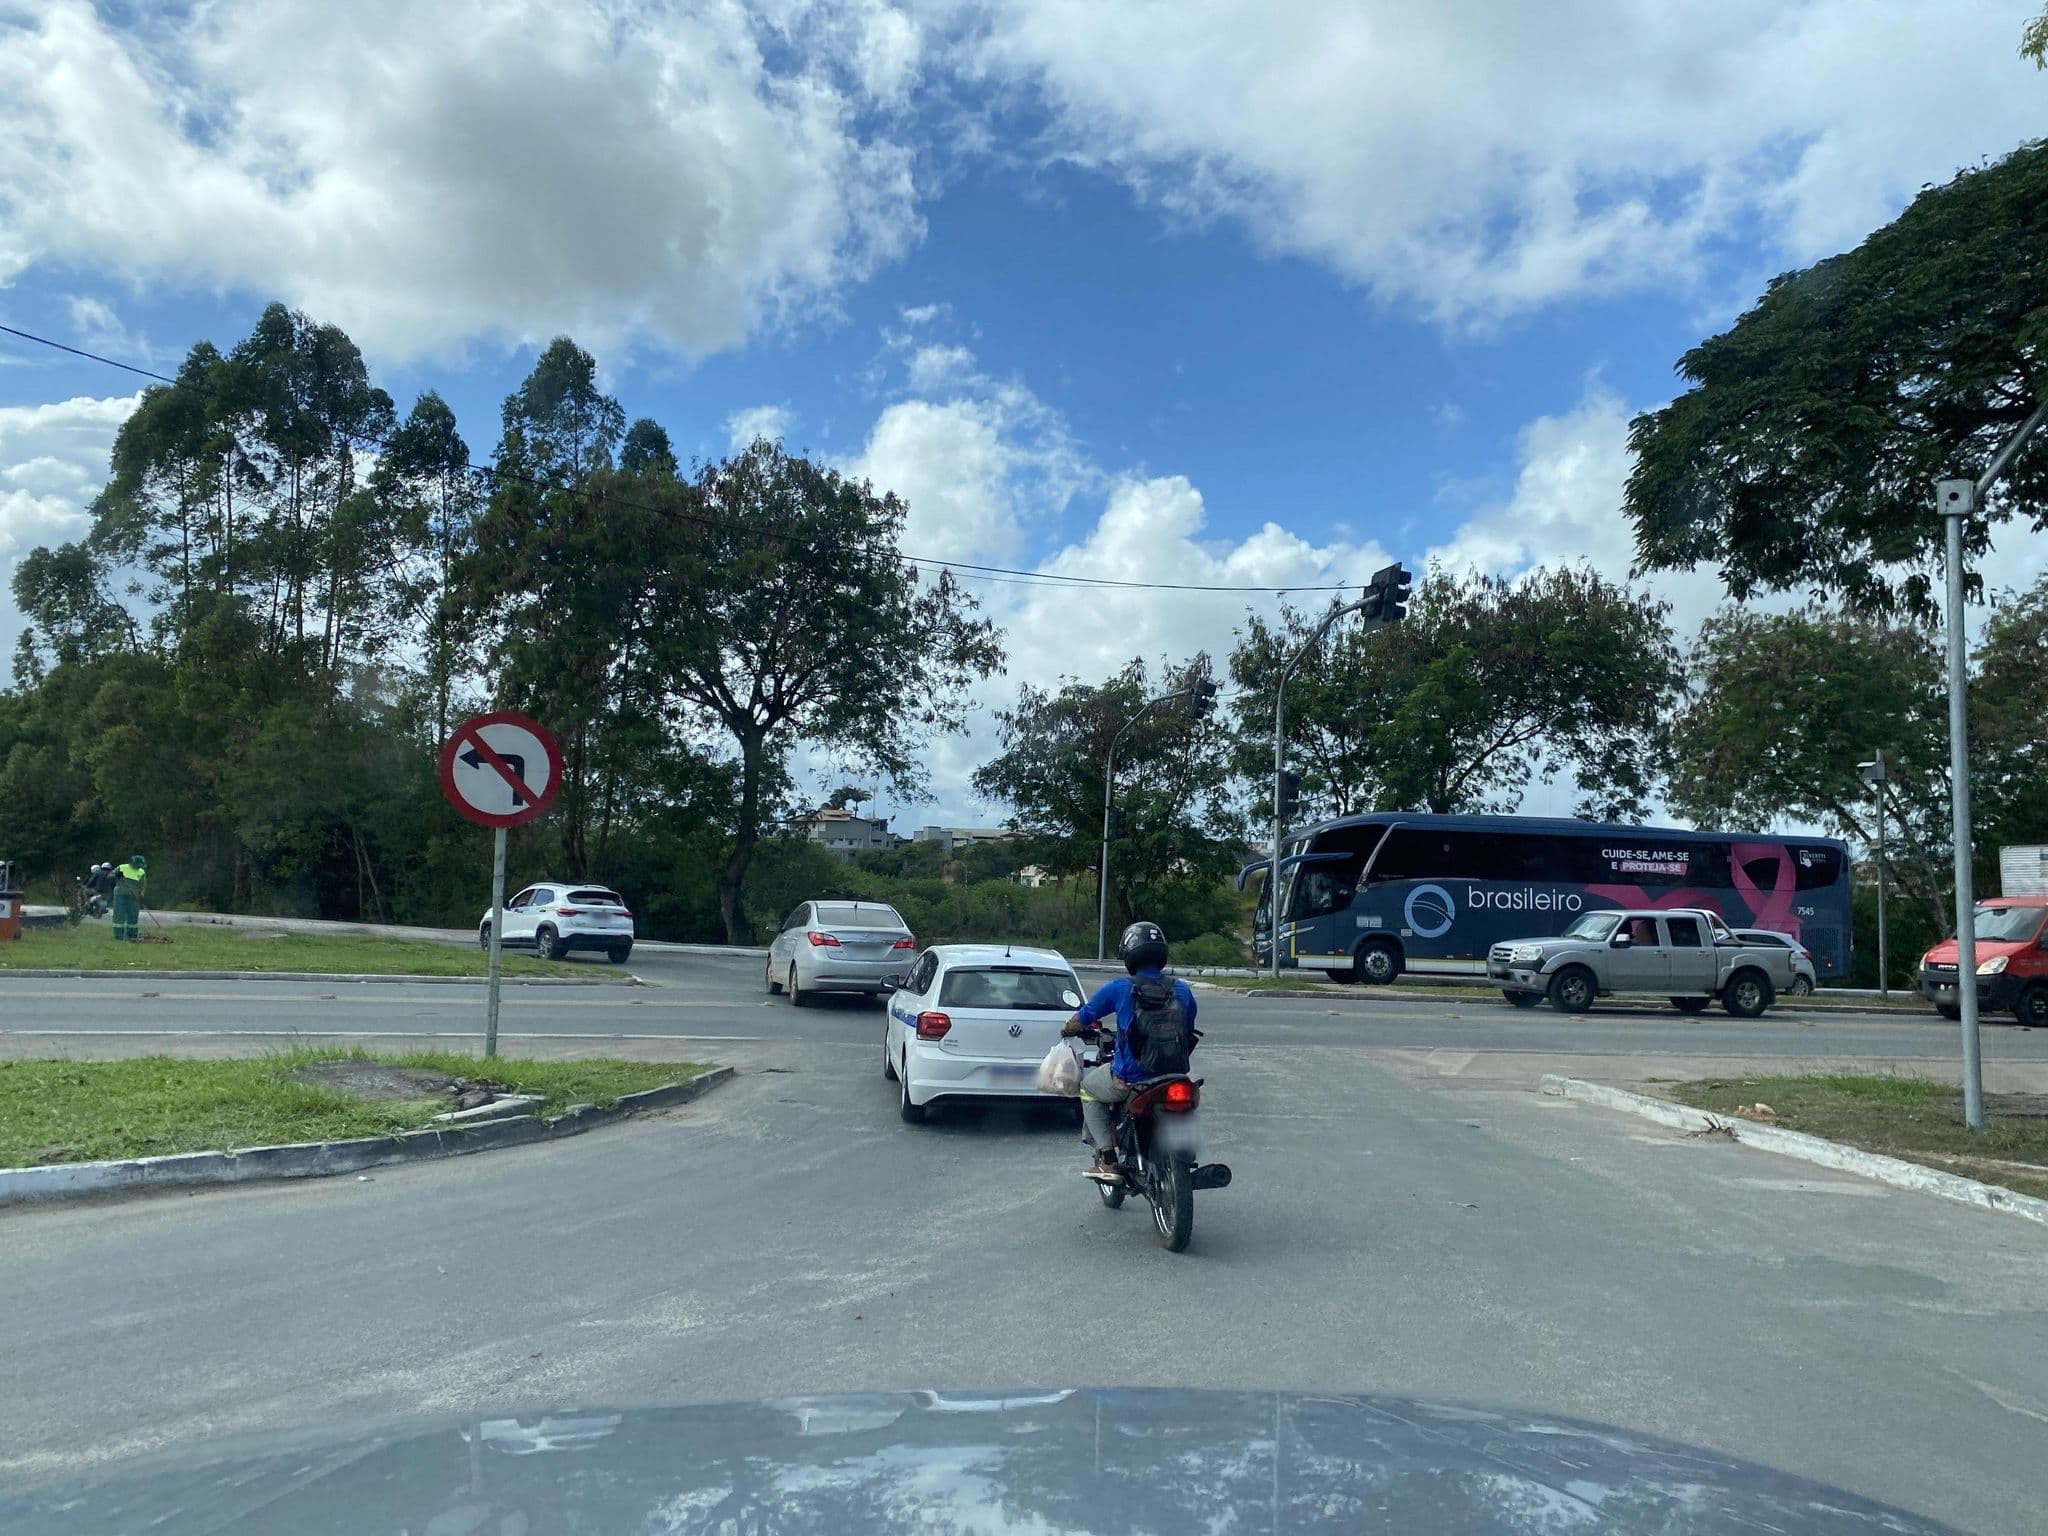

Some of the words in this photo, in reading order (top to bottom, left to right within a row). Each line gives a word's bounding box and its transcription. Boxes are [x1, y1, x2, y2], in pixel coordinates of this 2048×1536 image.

[1602, 849, 1650, 860] CUIDE-SE,
[1652, 851, 1689, 861] AME-SE
[1611, 861, 1618, 870] E
[1622, 862, 1682, 872] PROTEJA-SE
[1468, 885, 1582, 911] brasileiro
[1797, 907, 1815, 916] 7545
